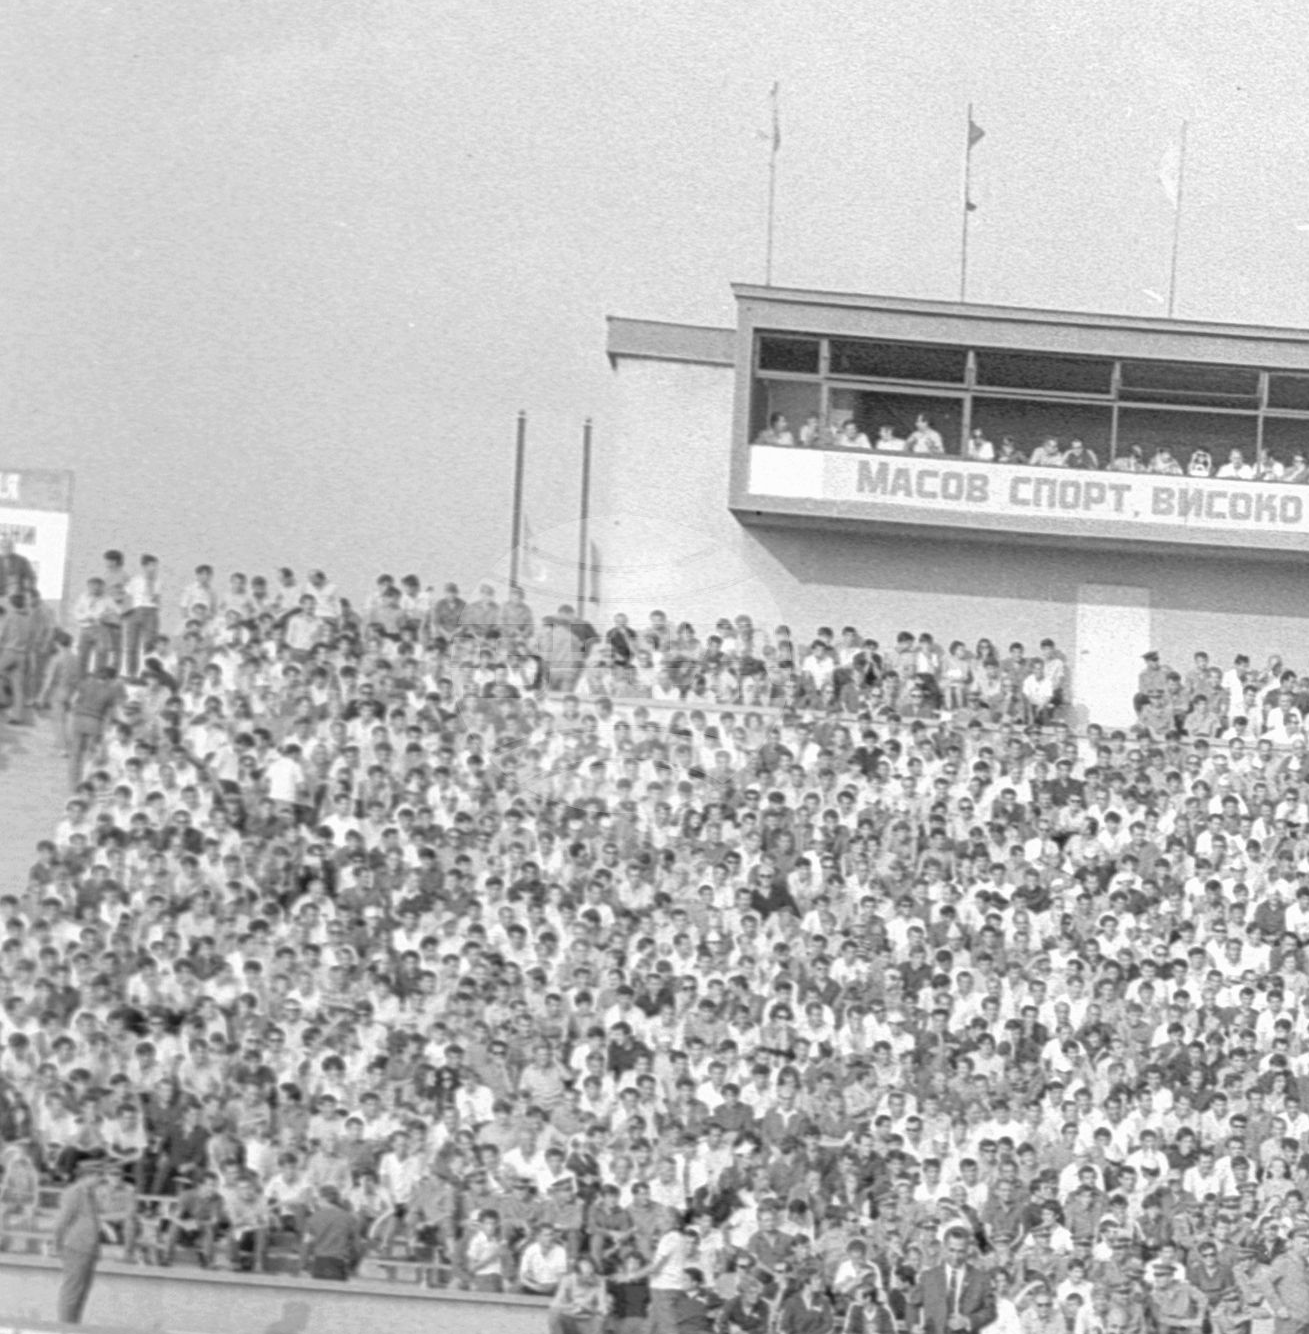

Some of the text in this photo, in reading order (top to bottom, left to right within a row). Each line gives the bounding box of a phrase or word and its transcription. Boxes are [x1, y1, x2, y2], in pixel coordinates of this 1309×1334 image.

[856, 460, 990, 503] МАСОВ
[1008, 475, 1141, 518] СПОРТ,
[1150, 485, 1303, 525] ВИСОКО
